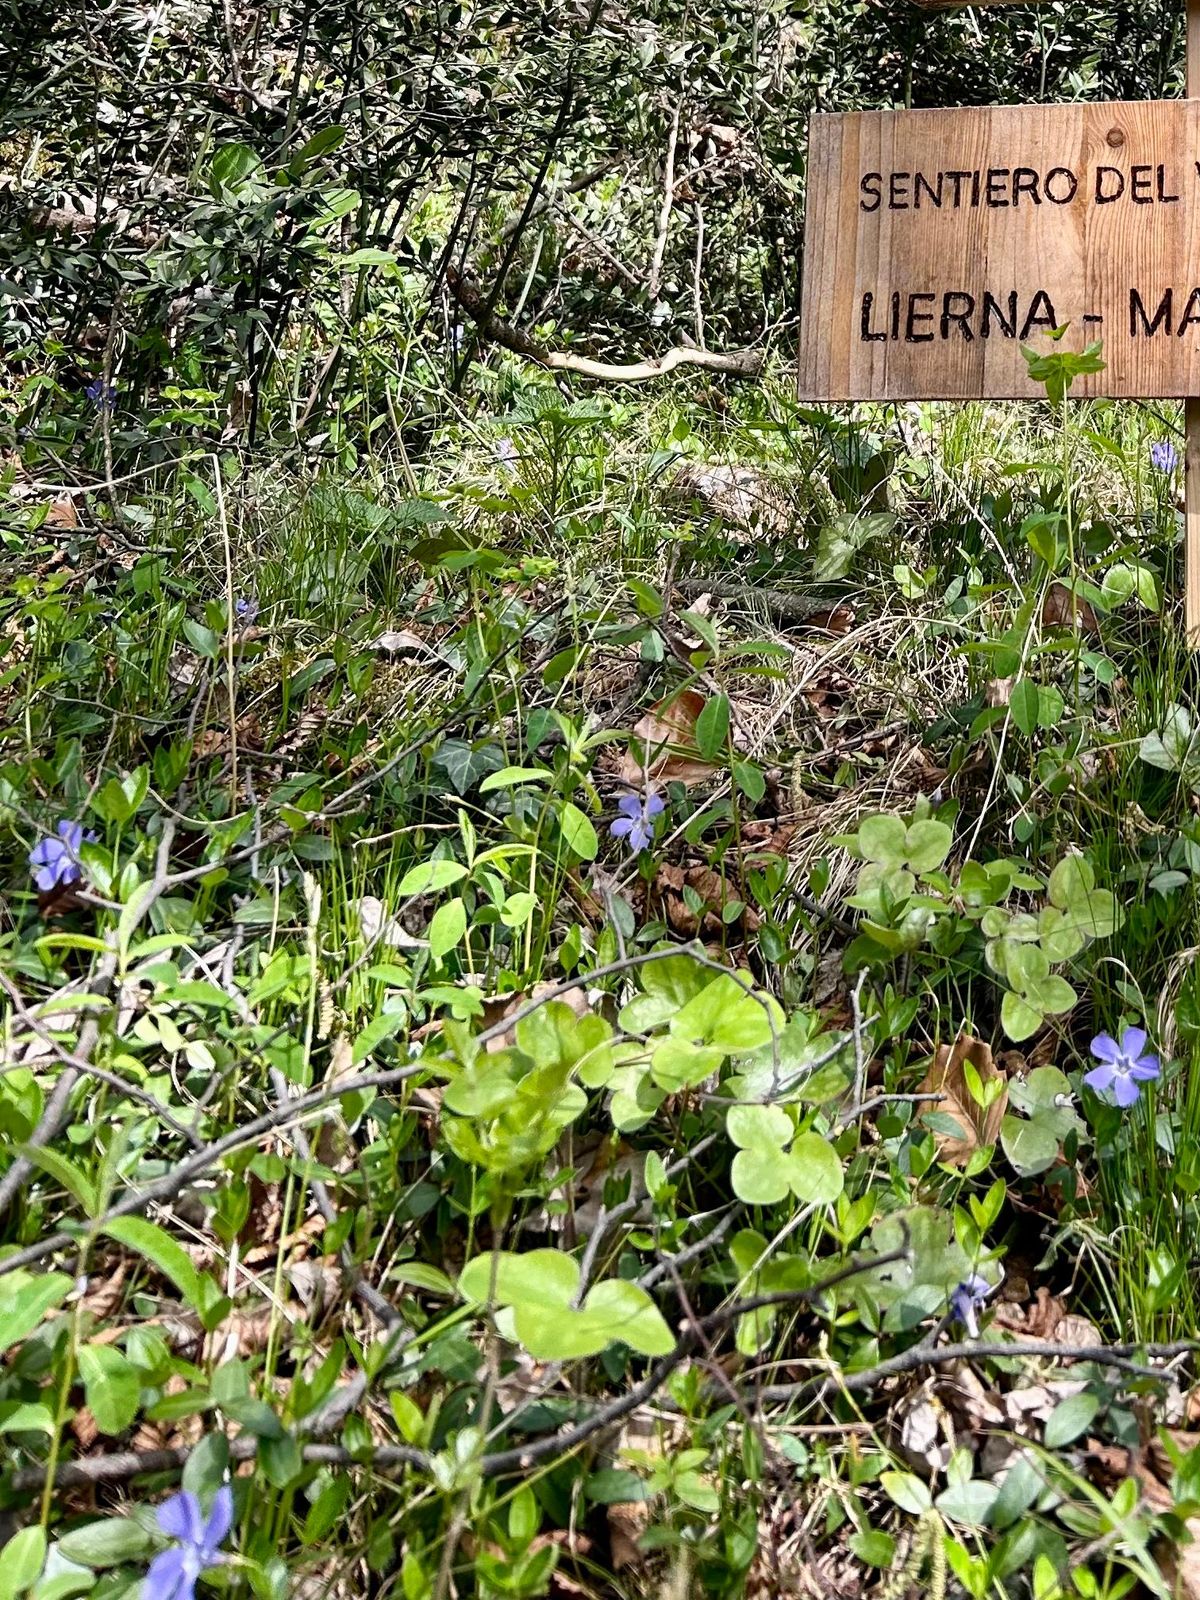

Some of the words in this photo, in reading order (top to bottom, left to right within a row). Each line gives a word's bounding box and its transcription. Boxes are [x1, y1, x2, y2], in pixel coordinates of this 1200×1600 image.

[859, 166, 1078, 213] SENTIERO
[1094, 163, 1179, 205] DEL
[860, 290, 1058, 343] LIERNA
[1083, 314, 1103, 324] -
